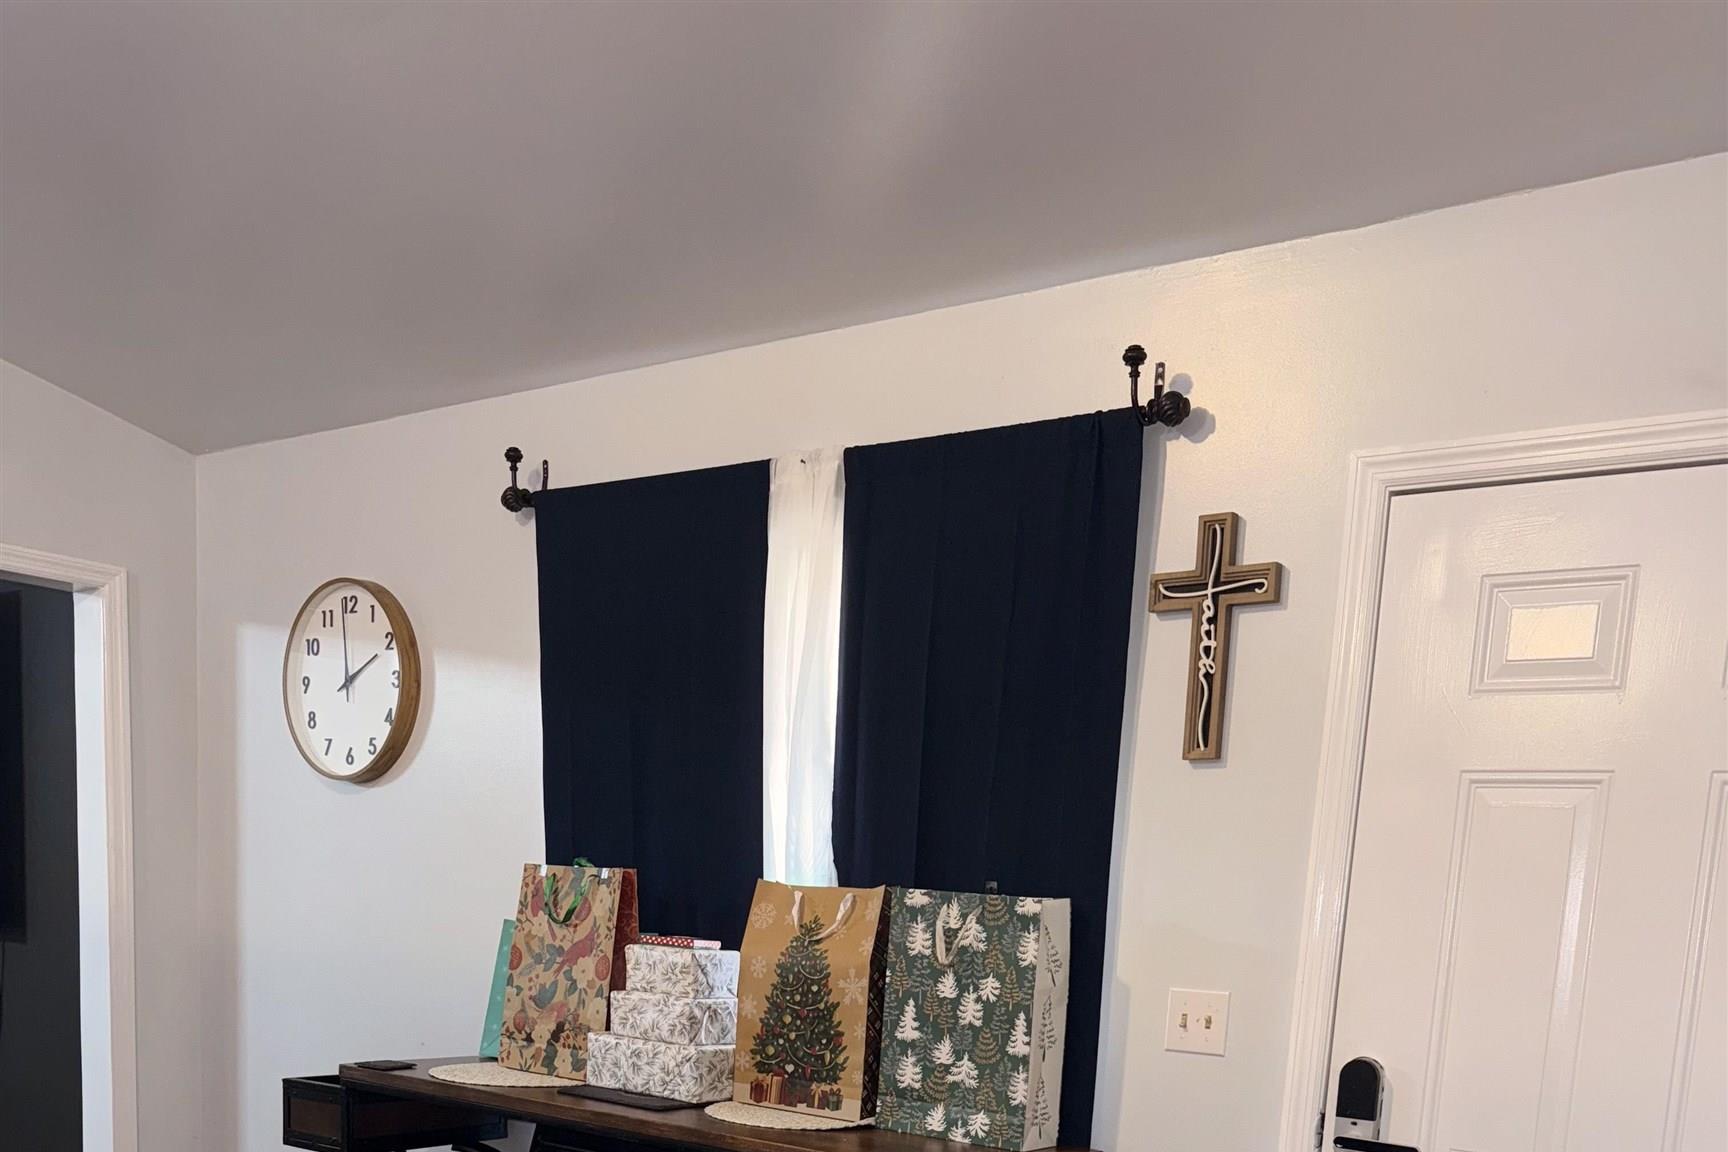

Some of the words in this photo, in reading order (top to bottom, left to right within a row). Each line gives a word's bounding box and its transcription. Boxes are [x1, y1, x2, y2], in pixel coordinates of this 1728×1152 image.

[343, 595, 358, 614] 12
[369, 604, 375, 623] 1
[321, 609, 334, 628] 11
[305, 638, 320, 656] 10
[385, 631, 394, 650] 2
[302, 676, 311, 694] 9
[391, 670, 400, 689] 3
[307, 711, 317, 729] 8
[384, 707, 394, 726] 4
[324, 738, 333, 756] 7
[368, 737, 377, 755] 5
[345, 747, 354, 765] 6
